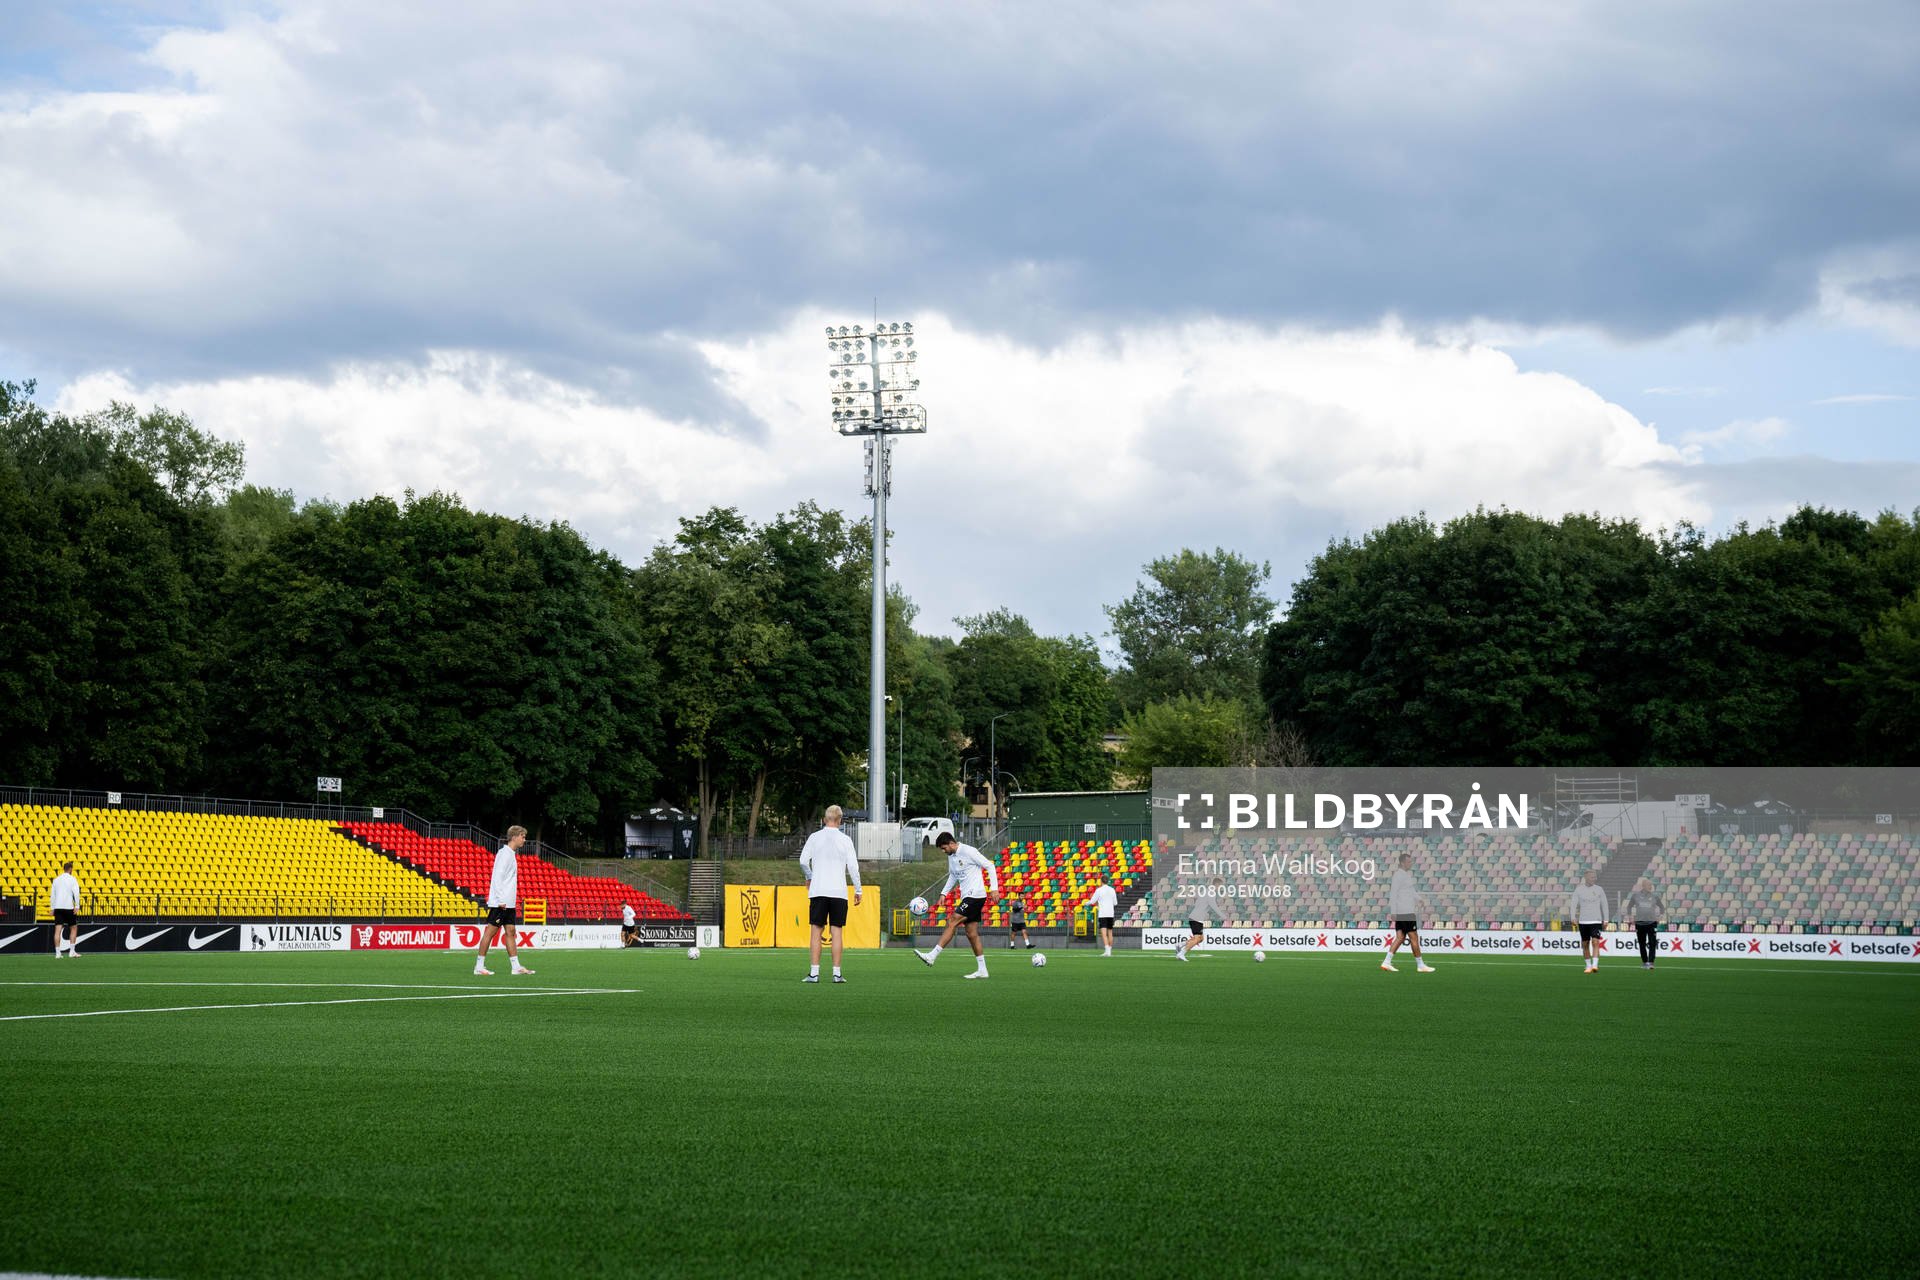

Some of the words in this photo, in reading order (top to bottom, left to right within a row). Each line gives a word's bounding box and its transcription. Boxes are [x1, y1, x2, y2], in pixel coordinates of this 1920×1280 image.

[1877, 814, 1890, 822] PC
[268, 926, 342, 941] VILNIAUS
[378, 930, 446, 945] SPORTLAND.LT
[1206, 933, 1251, 946] betsafe
[1269, 934, 1316, 947] betsafe
[1334, 935, 1382, 948] betsafe
[1402, 935, 1451, 948] btsafe
[1471, 936, 1521, 949] betsafe
[1542, 937, 1586, 950] betsa
[1615, 938, 1669, 951] betfe
[1692, 939, 1747, 952] betsafe
[1769, 940, 1827, 954] betsafe
[1851, 942, 1911, 956] betsafe
